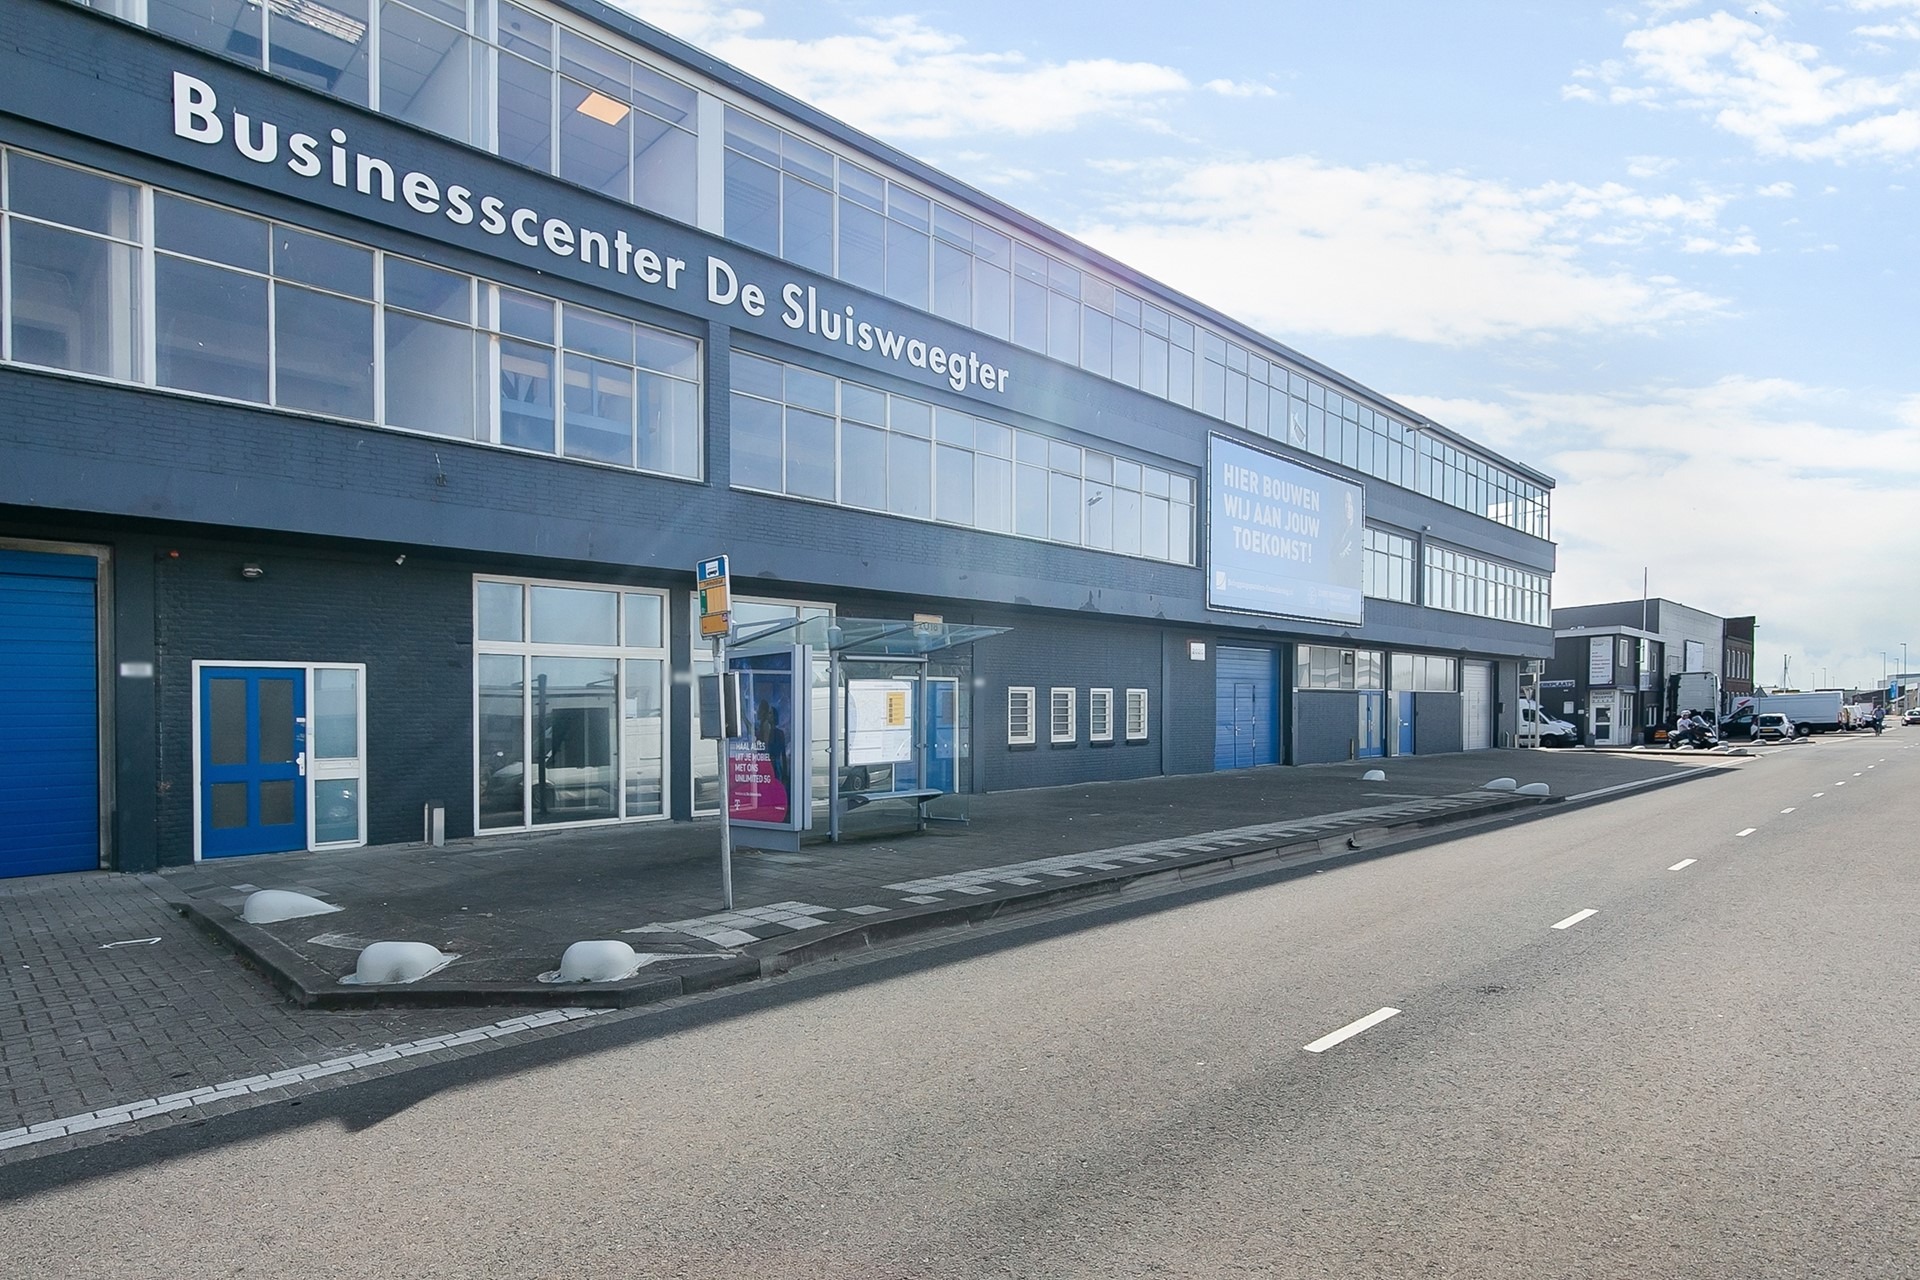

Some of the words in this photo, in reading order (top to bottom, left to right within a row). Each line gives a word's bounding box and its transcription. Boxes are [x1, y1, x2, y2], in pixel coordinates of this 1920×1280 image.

[172, 70, 687, 291] Businesscenter
[706, 255, 766, 317] De
[781, 282, 1010, 393] Sluiswaegter
[1223, 462, 1259, 495] HIER
[1262, 475, 1320, 512] BOUWEN
[1223, 493, 1250, 521] WIJ
[1253, 501, 1281, 529] AAN
[1284, 510, 1320, 538] JOUW
[1232, 525, 1312, 564] TOEKOMST!
[735, 742, 750, 751] HAAL
[751, 741, 766, 751] ALLES
[752, 752, 771, 762] MOBIEL
[734, 763, 746, 772] MET
[747, 763, 759, 773] ONS
[734, 774, 763, 783] UNLIMITED
[763, 775, 771, 784] 5G
